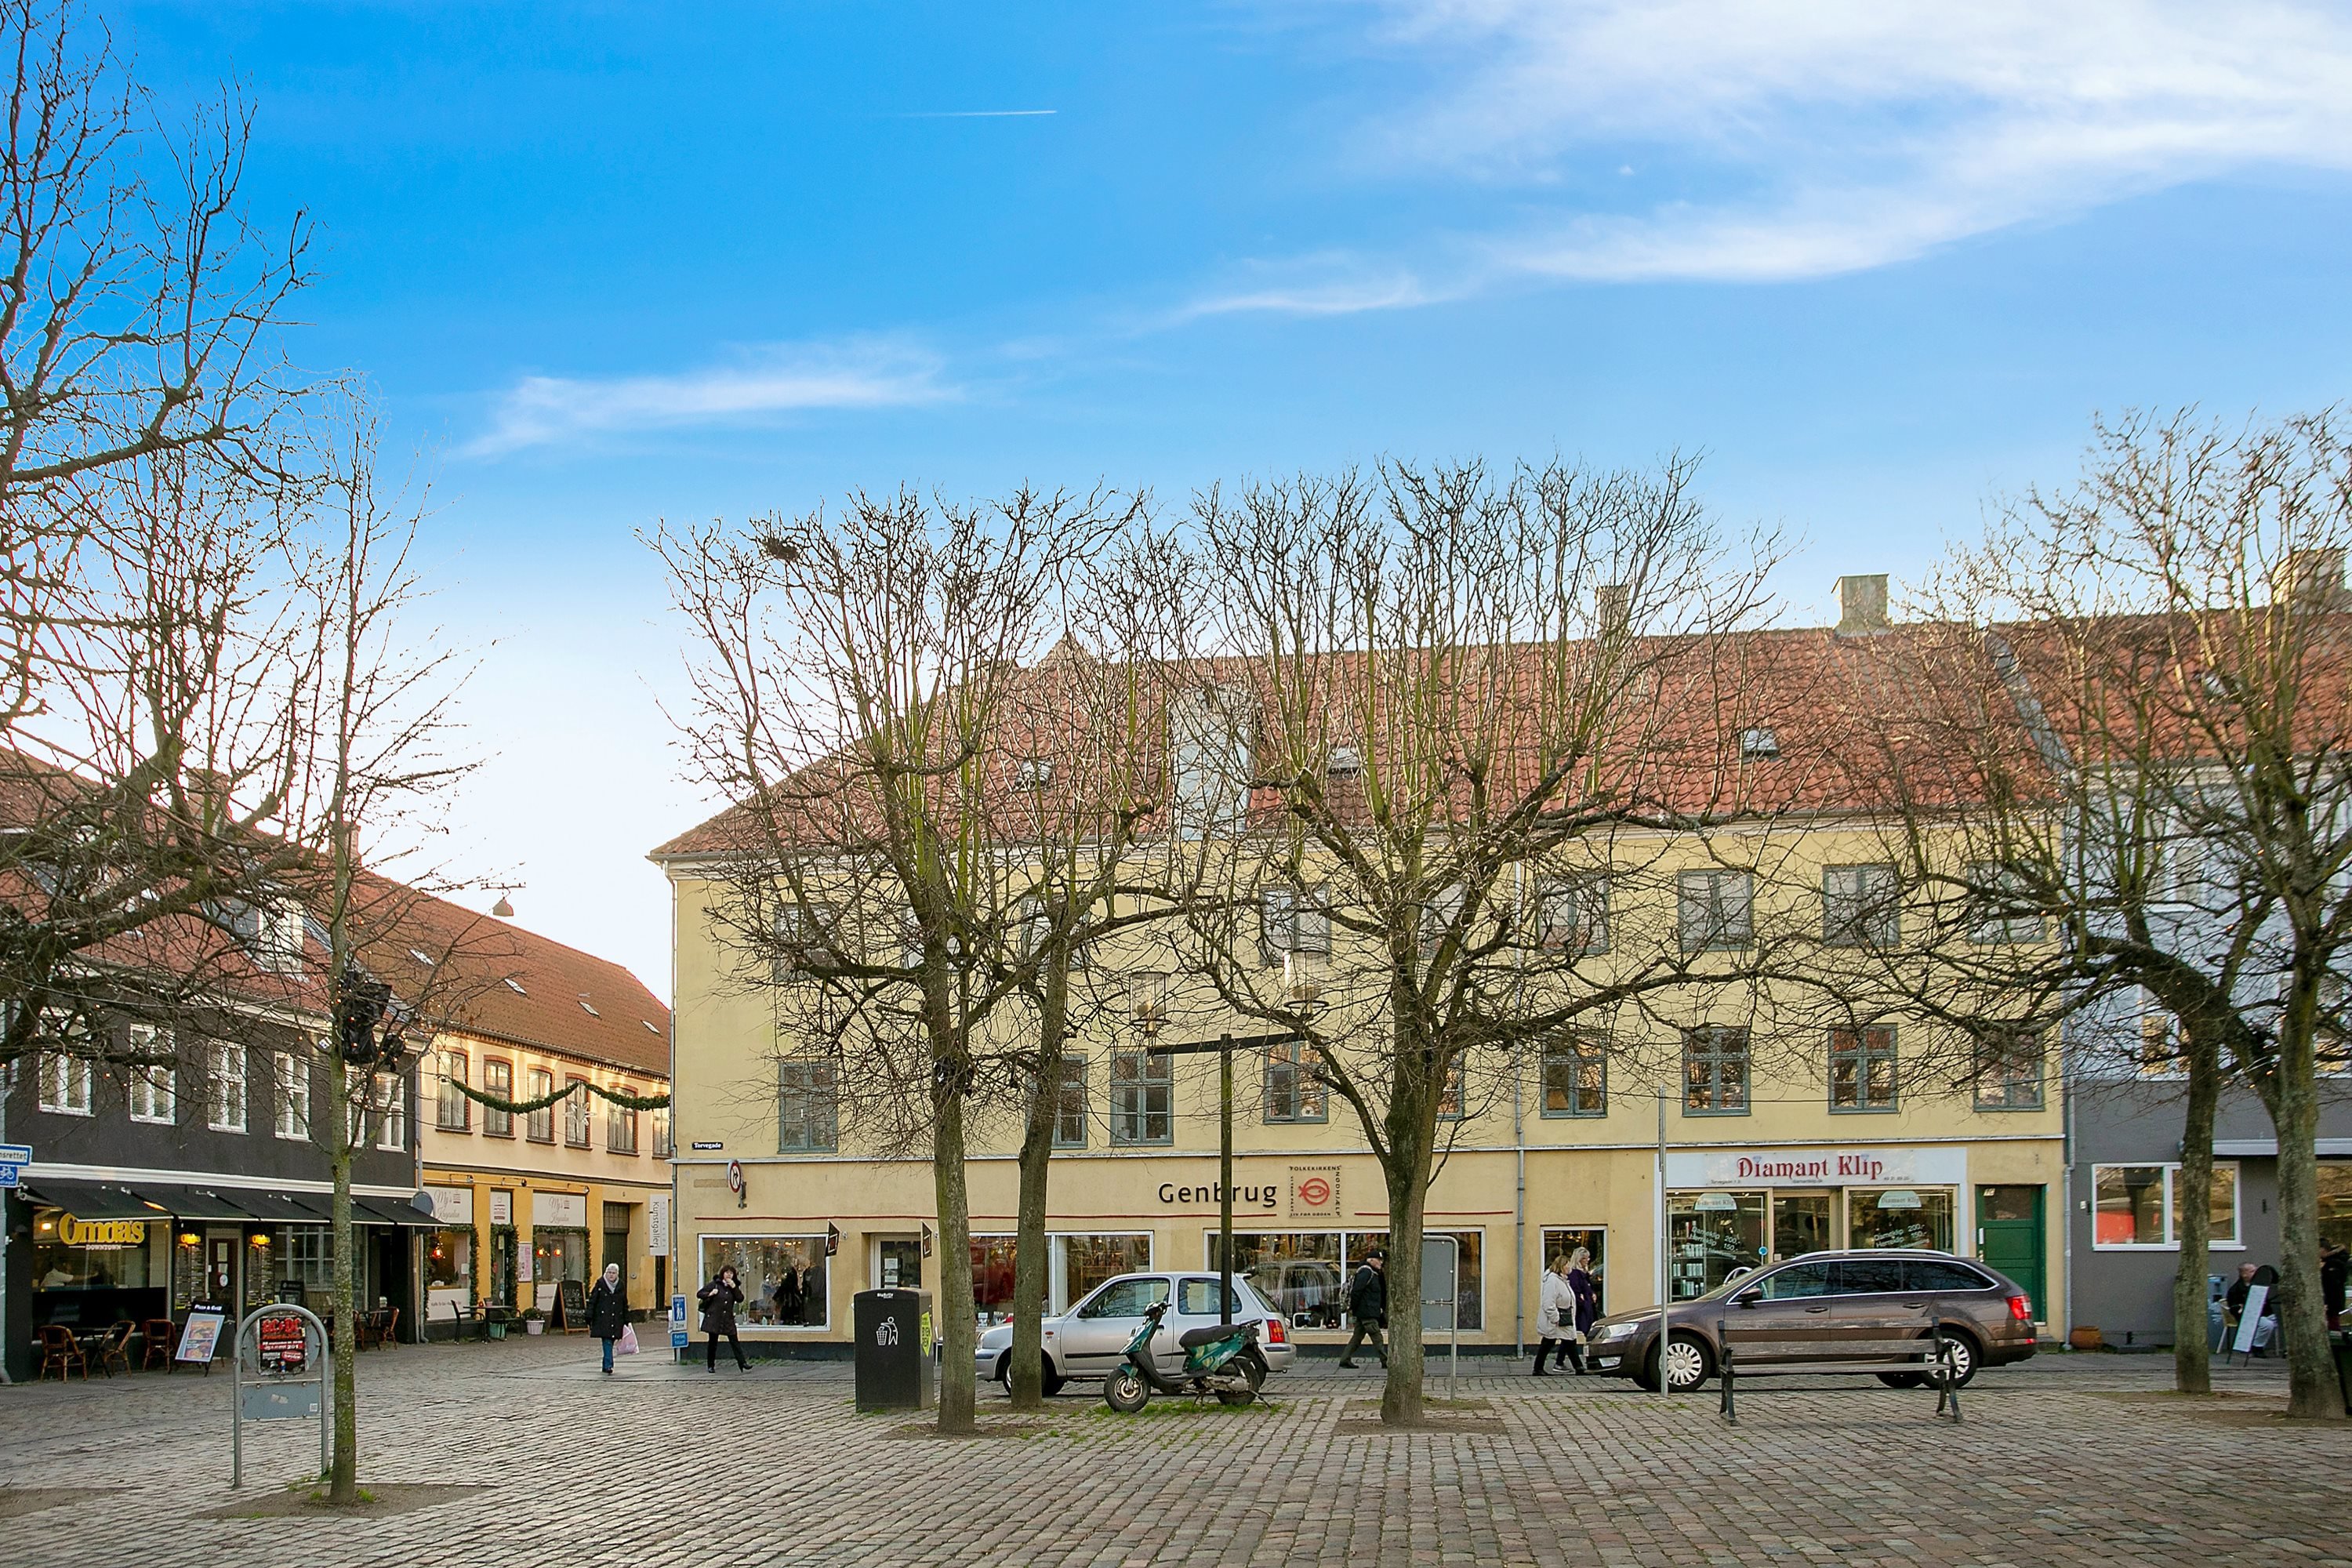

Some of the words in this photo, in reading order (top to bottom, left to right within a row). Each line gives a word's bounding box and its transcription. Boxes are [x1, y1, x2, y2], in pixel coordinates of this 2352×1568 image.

[1737, 1156, 1828, 1179] Diamant
[1838, 1155, 1882, 1180] Klip
[1159, 1181, 1277, 1208] Genbrug
[652, 1201, 660, 1248] Kunstgalleri
